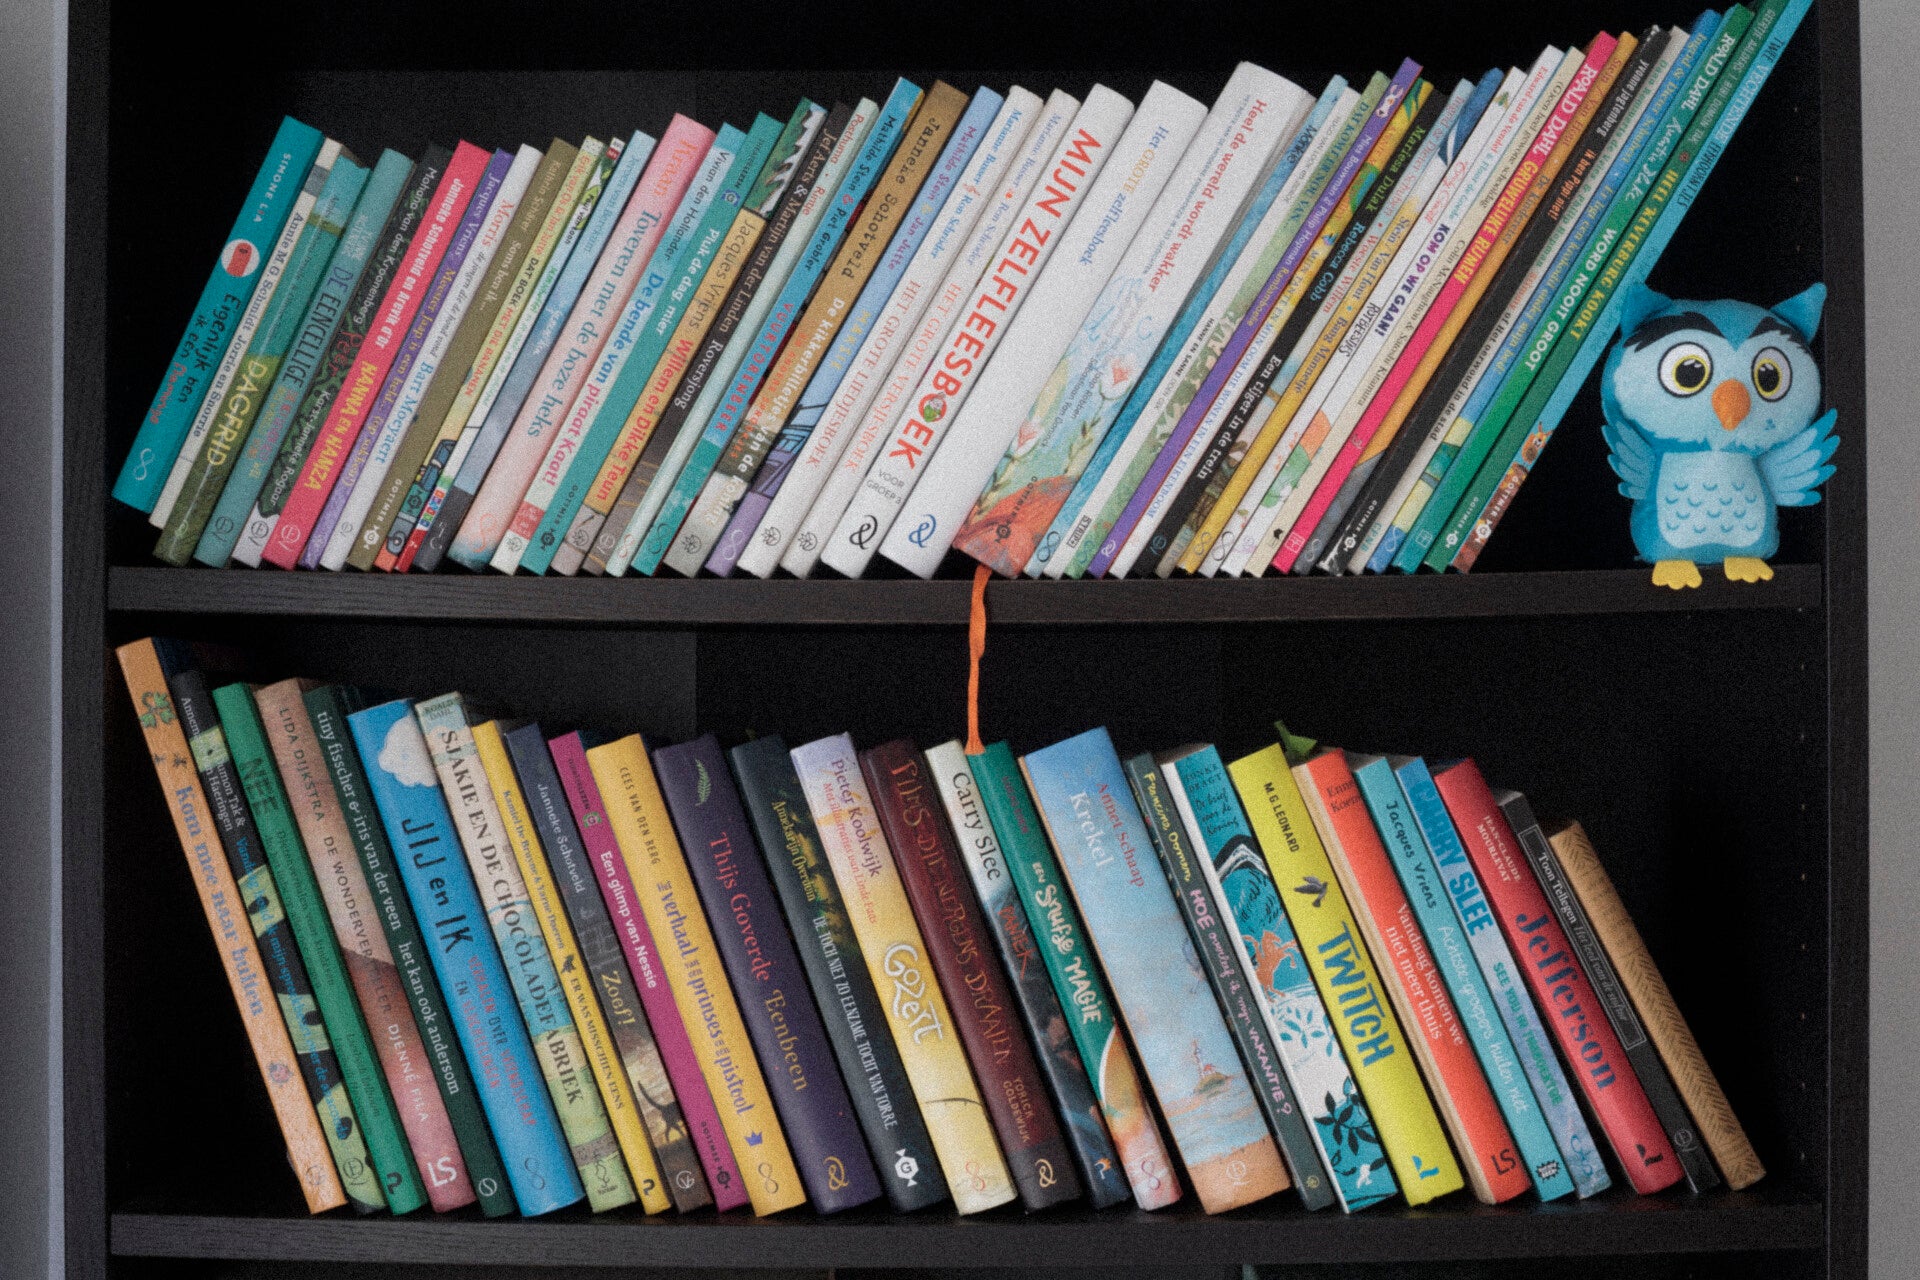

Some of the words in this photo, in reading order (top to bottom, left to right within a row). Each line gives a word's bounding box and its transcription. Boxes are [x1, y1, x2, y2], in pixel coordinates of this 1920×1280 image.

[1623, 58, 1649, 90] yvonne
[1679, 74, 1709, 113] DAHL
[1238, 97, 1268, 134] Heel
[1593, 86, 1633, 138] jagtenberg
[1146, 124, 1169, 150] Het
[1228, 130, 1248, 152] de
[1388, 124, 1426, 174] Mariesa
[1530, 112, 1567, 158] DAHL
[1582, 148, 1596, 160] ik
[407, 165, 437, 211] Mohana
[1034, 127, 1104, 219] MIJN
[1120, 147, 1156, 195] GROTE
[1200, 148, 1238, 200] wereld
[1555, 174, 1579, 201] Pippi
[1571, 157, 1590, 179] ben
[1650, 168, 1679, 204] HEEL
[1363, 174, 1395, 214] Dulak
[1545, 197, 1566, 220] niet!
[278, 210, 304, 250] Annie
[397, 209, 414, 232] van
[479, 197, 514, 249] Morris
[1076, 191, 1130, 269] zelfleesboek
[1175, 197, 1209, 242] wordt
[1425, 223, 1450, 254] KOM
[386, 231, 407, 256] den
[608, 204, 661, 283] Toveren
[695, 225, 721, 258] Pluk
[1328, 220, 1366, 270] Rebecca
[1581, 225, 1616, 273] WORD
[1598, 202, 1657, 289] KEVERBURG
[324, 264, 354, 294] DE
[686, 256, 704, 276] de
[1144, 239, 1184, 294] wakker
[1399, 272, 1420, 295] WE
[1412, 252, 1431, 274] OP
[240, 277, 273, 333] Schmidt
[350, 252, 395, 327] Kroonenberg
[588, 279, 622, 321] met
[638, 270, 664, 301] De
[1307, 269, 1335, 304] Cobb
[1552, 271, 1589, 321] NOOIT
[192, 312, 210, 330] ik
[192, 292, 241, 371] Eigenlijk
[573, 318, 603, 349] de
[610, 298, 650, 353] bende
[653, 304, 677, 337] mier
[1373, 293, 1407, 337] GAAN!
[1566, 287, 1605, 341] KOOKT
[177, 331, 199, 361] een
[220, 333, 248, 374] Jorrie
[280, 290, 342, 389] EENCELLIGE
[323, 327, 364, 381] Peer
[1522, 318, 1560, 371] GROOT
[213, 372, 226, 389] en
[406, 359, 435, 396] Bart
[549, 345, 589, 396] boze
[592, 351, 619, 385] van
[650, 334, 693, 397] Willem
[673, 337, 723, 412] Roversjong
[712, 299, 795, 433] VUURTORENBEER
[1259, 354, 1281, 380] Een
[175, 374, 198, 405] ben
[338, 359, 379, 419] HANNA
[639, 394, 659, 416] en
[1234, 377, 1266, 416] tijger
[190, 389, 222, 439] Snorrie
[202, 357, 269, 469] DAGFRID
[331, 415, 350, 436] EN
[371, 391, 418, 466] Moeyaert
[525, 392, 564, 443] heks
[562, 382, 604, 439] piraat
[1227, 414, 1243, 430] in
[614, 414, 651, 464] Dikke
[1216, 429, 1234, 448] de
[303, 433, 344, 493] HAMZA
[540, 436, 576, 487] Kaat!
[593, 460, 626, 504] Teun
[1195, 446, 1223, 481] trein
[312, 709, 340, 743] tiny
[277, 706, 300, 746] LIDA
[291, 748, 327, 822] DIJKSTRA
[327, 741, 360, 799] fisscher
[436, 728, 481, 808] SJAKIE
[352, 814, 374, 841] iris
[465, 809, 492, 842] EN
[827, 756, 859, 806] Pieter
[843, 804, 885, 879] Koolwijk
[946, 770, 987, 835] Carry
[973, 833, 1004, 882] Slee
[1069, 790, 1113, 868] Krekel
[361, 840, 381, 868] van
[401, 814, 444, 870] JIJ
[477, 842, 505, 876] DE
[1382, 799, 1420, 860] Jacques
[1409, 861, 1440, 910] Vriens
[371, 868, 394, 896] der
[599, 849, 619, 878] Een
[174, 785, 207, 837] Kom
[192, 841, 221, 886] mee
[209, 890, 240, 942] naar
[229, 946, 267, 1016] buiten
[427, 875, 452, 907] en
[606, 877, 634, 919] glimp
[1536, 851, 1558, 881] Toon
[1548, 879, 1579, 925] Tellegen
[380, 896, 403, 931] veen
[434, 913, 474, 954] IK
[623, 918, 640, 944] van
[810, 914, 829, 932] DE
[396, 940, 418, 966] het
[706, 831, 740, 891] Thijs
[727, 891, 770, 983] Goverde
[765, 989, 807, 1091] Eenbeen
[816, 930, 839, 958] TOCH
[405, 965, 428, 995] kan
[632, 944, 659, 989] Nessie
[825, 957, 847, 982] NIET
[833, 979, 852, 996] ZO
[1384, 923, 1410, 957] niet
[1400, 959, 1426, 1000] meer
[1417, 998, 1445, 1041] thuis
[1393, 902, 1432, 970] Vandaag
[1422, 969, 1454, 1022] komen
[1445, 1021, 1463, 1047] we
[416, 994, 438, 1024] ook
[489, 875, 585, 1105] CHOCOLADEFABRIEK
[599, 970, 636, 1029] Zoef!
[657, 889, 699, 959] verhaal
[687, 976, 725, 1040] prinses
[715, 1053, 753, 1115] pistool
[1317, 918, 1395, 1067] TWITCH
[1515, 910, 1616, 1090] Jefferson
[838, 994, 868, 1042] EENZAME
[425, 1023, 463, 1095] andersom
[854, 1040, 879, 1074] TOCHT
[866, 1072, 886, 1094] VAN
[873, 1092, 898, 1130] TORRE
